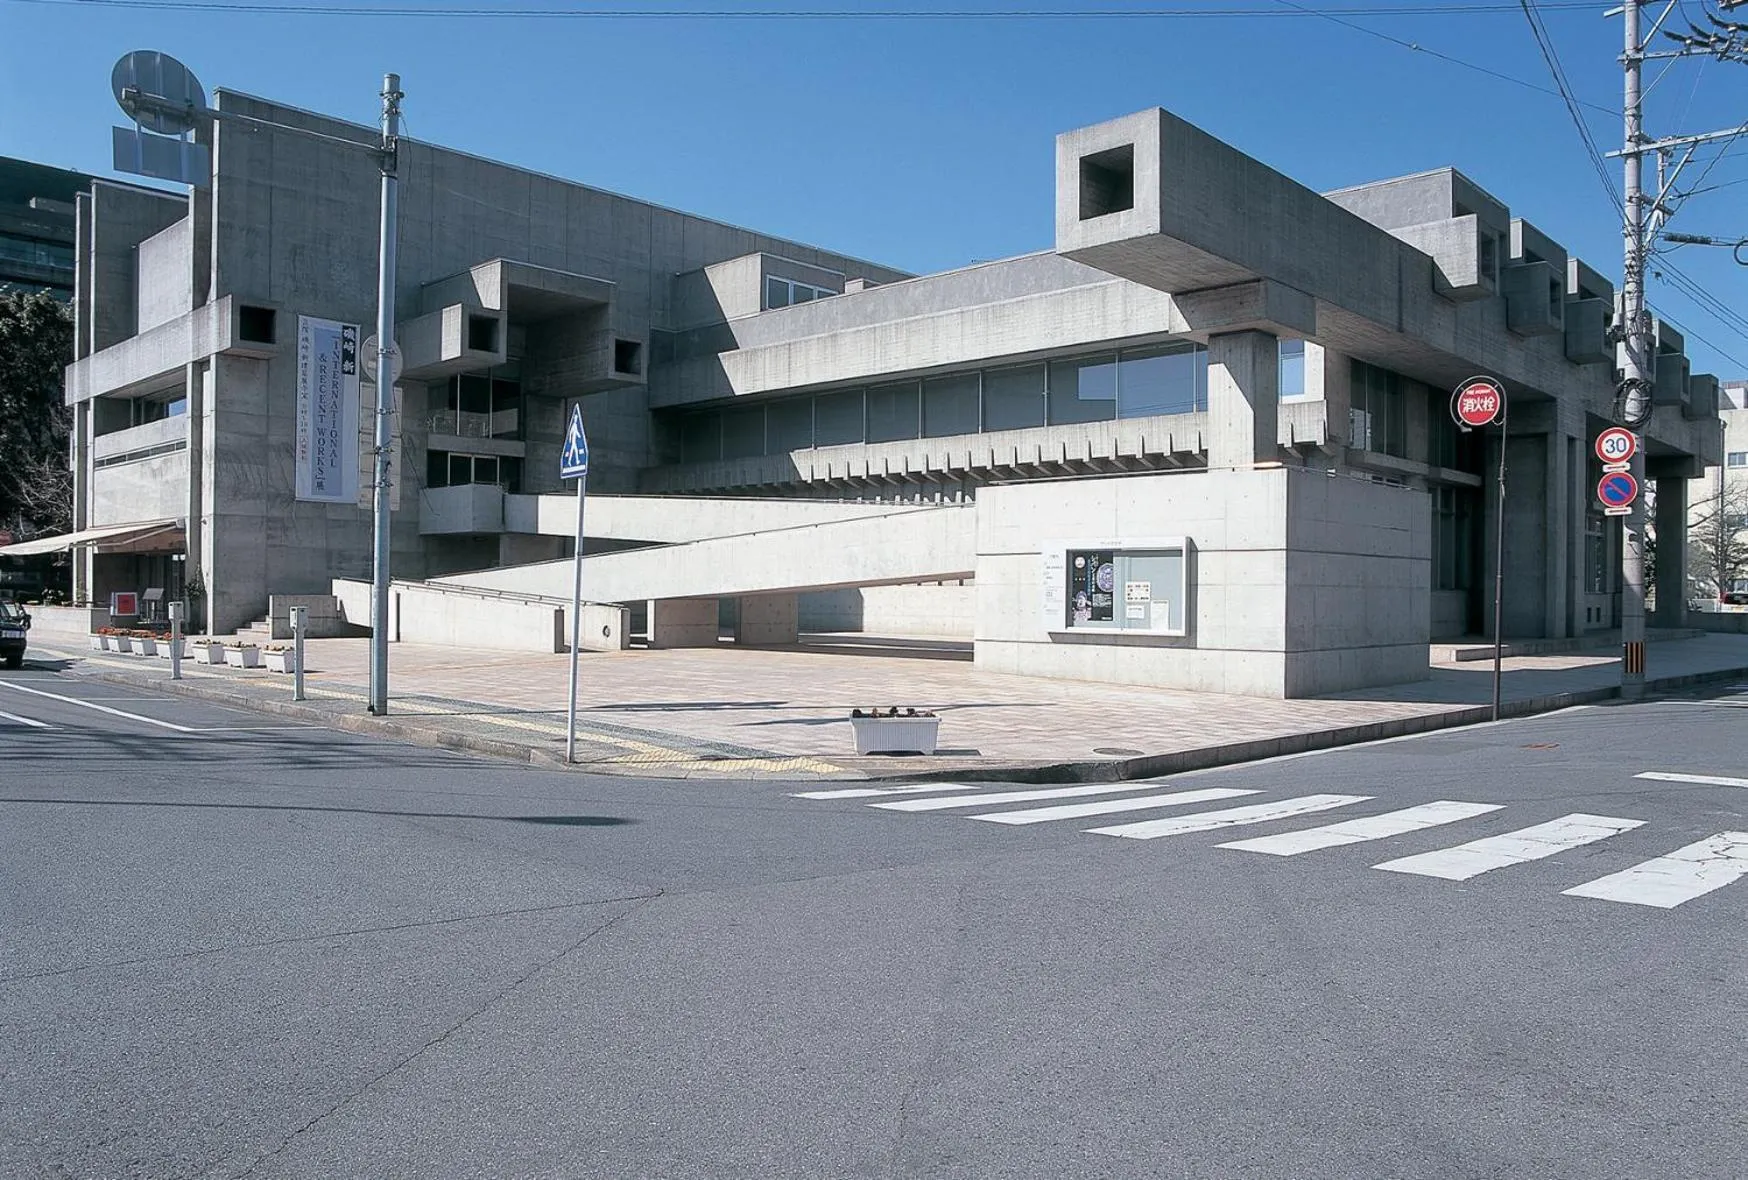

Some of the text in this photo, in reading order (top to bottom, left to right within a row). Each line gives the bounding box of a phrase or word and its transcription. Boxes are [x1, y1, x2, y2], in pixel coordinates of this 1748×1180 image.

[319, 364, 327, 423] RECENT
[1462, 396, 1496, 413] 消火栓
[1606, 438, 1627, 453] 30
